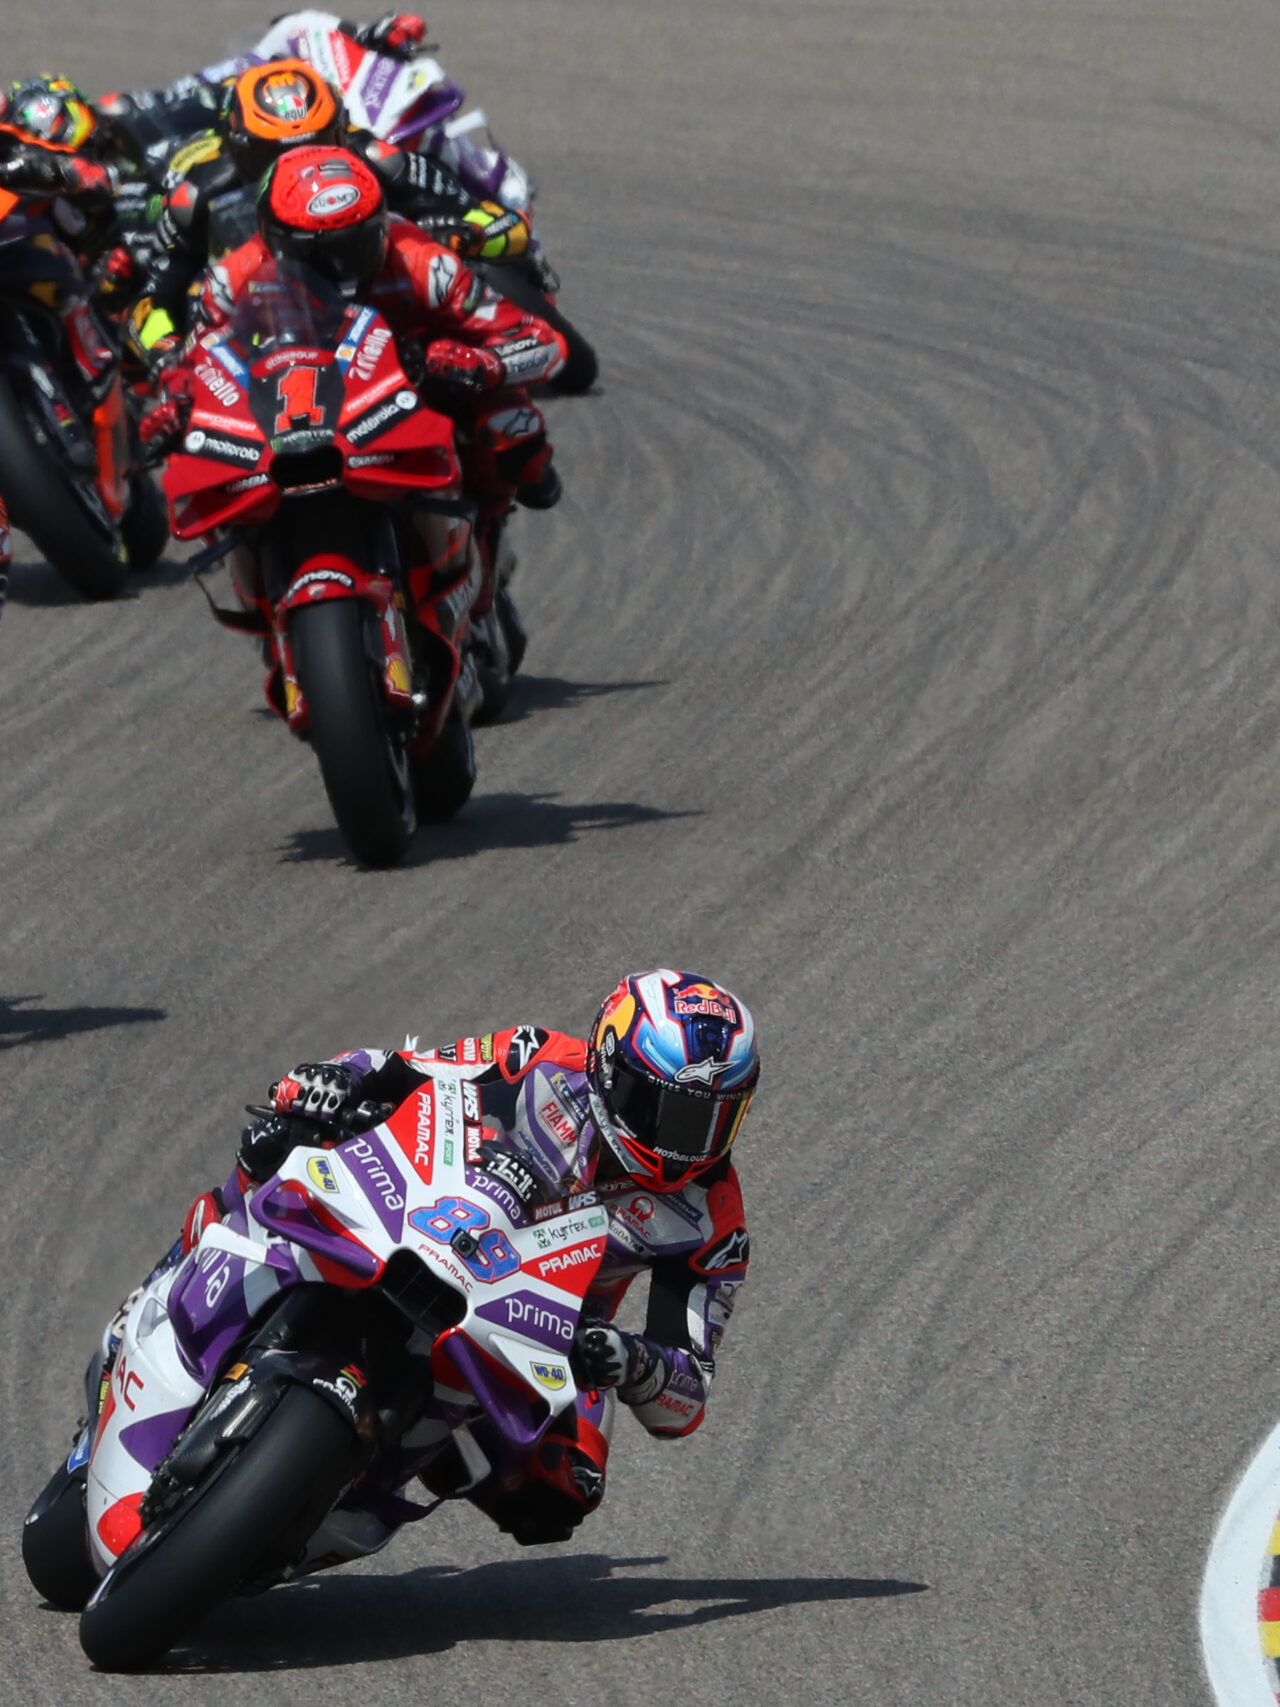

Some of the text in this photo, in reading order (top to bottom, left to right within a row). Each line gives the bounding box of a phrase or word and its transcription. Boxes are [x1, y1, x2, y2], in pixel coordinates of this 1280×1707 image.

[274, 365, 324, 435] 1
[346, 403, 400, 443] motorola
[205, 437, 260, 461] motorola
[674, 1000, 737, 1024] Red Bull
[647, 1074, 680, 1093] GIVES
[687, 1088, 711, 1099] YOU
[414, 1091, 432, 1167] PRAMAC
[541, 1101, 577, 1147] FIAMM
[466, 1128, 481, 1161] MOTUL
[653, 1146, 708, 1162] MOTOBLOUZ
[315, 1159, 336, 1191] WD-40
[344, 1137, 404, 1211] prima
[471, 1175, 521, 1220] prima
[535, 1203, 563, 1221] MOTUL
[610, 1204, 652, 1240] PRAMAC
[408, 1196, 521, 1285] 89
[418, 1243, 474, 1294] PRAMAC
[538, 1243, 602, 1277] PRAMAC
[504, 1298, 575, 1340] prima
[535, 1364, 564, 1381] WD-40
